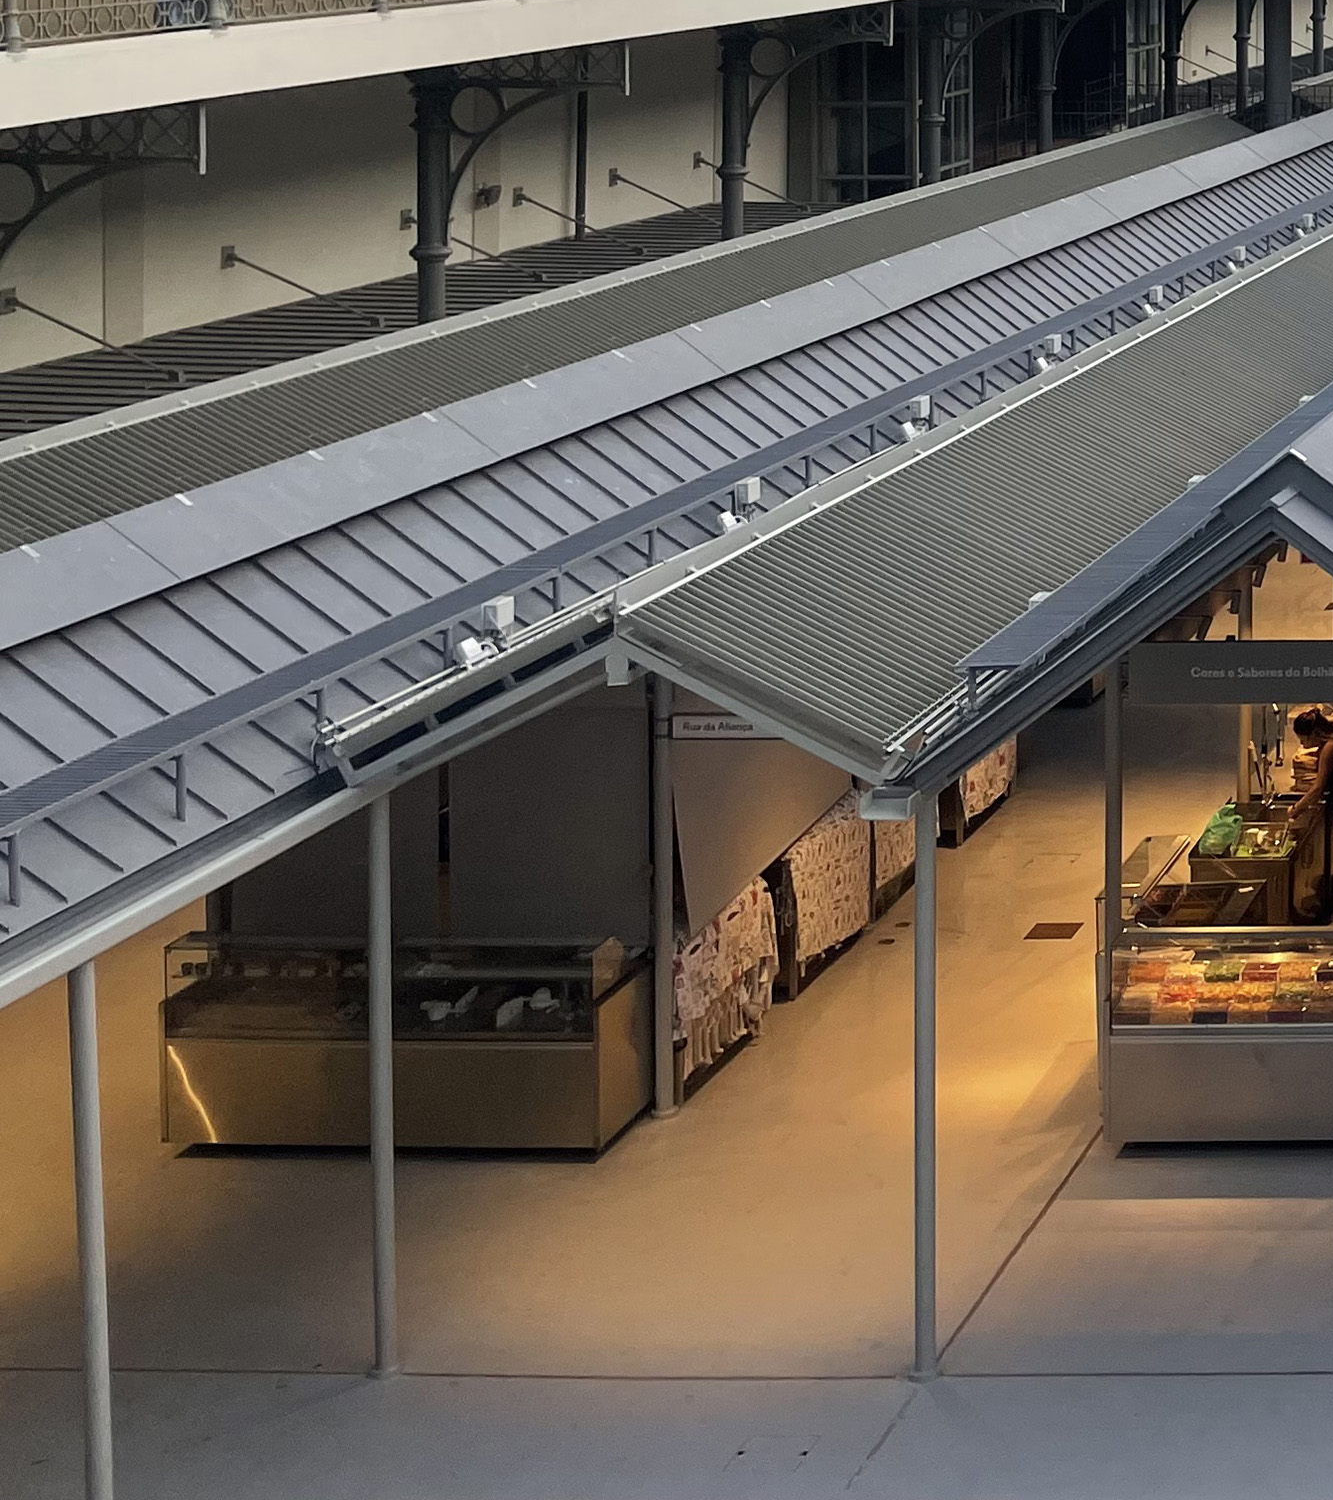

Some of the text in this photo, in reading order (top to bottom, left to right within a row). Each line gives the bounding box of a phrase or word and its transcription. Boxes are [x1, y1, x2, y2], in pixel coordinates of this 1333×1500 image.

[1190, 666, 1225, 678] Cores
[1228, 668, 1235, 678] e
[1237, 666, 1283, 678] Sabores
[1285, 666, 1300, 677] do
[682, 721, 754, 732] Rua da Aliança
